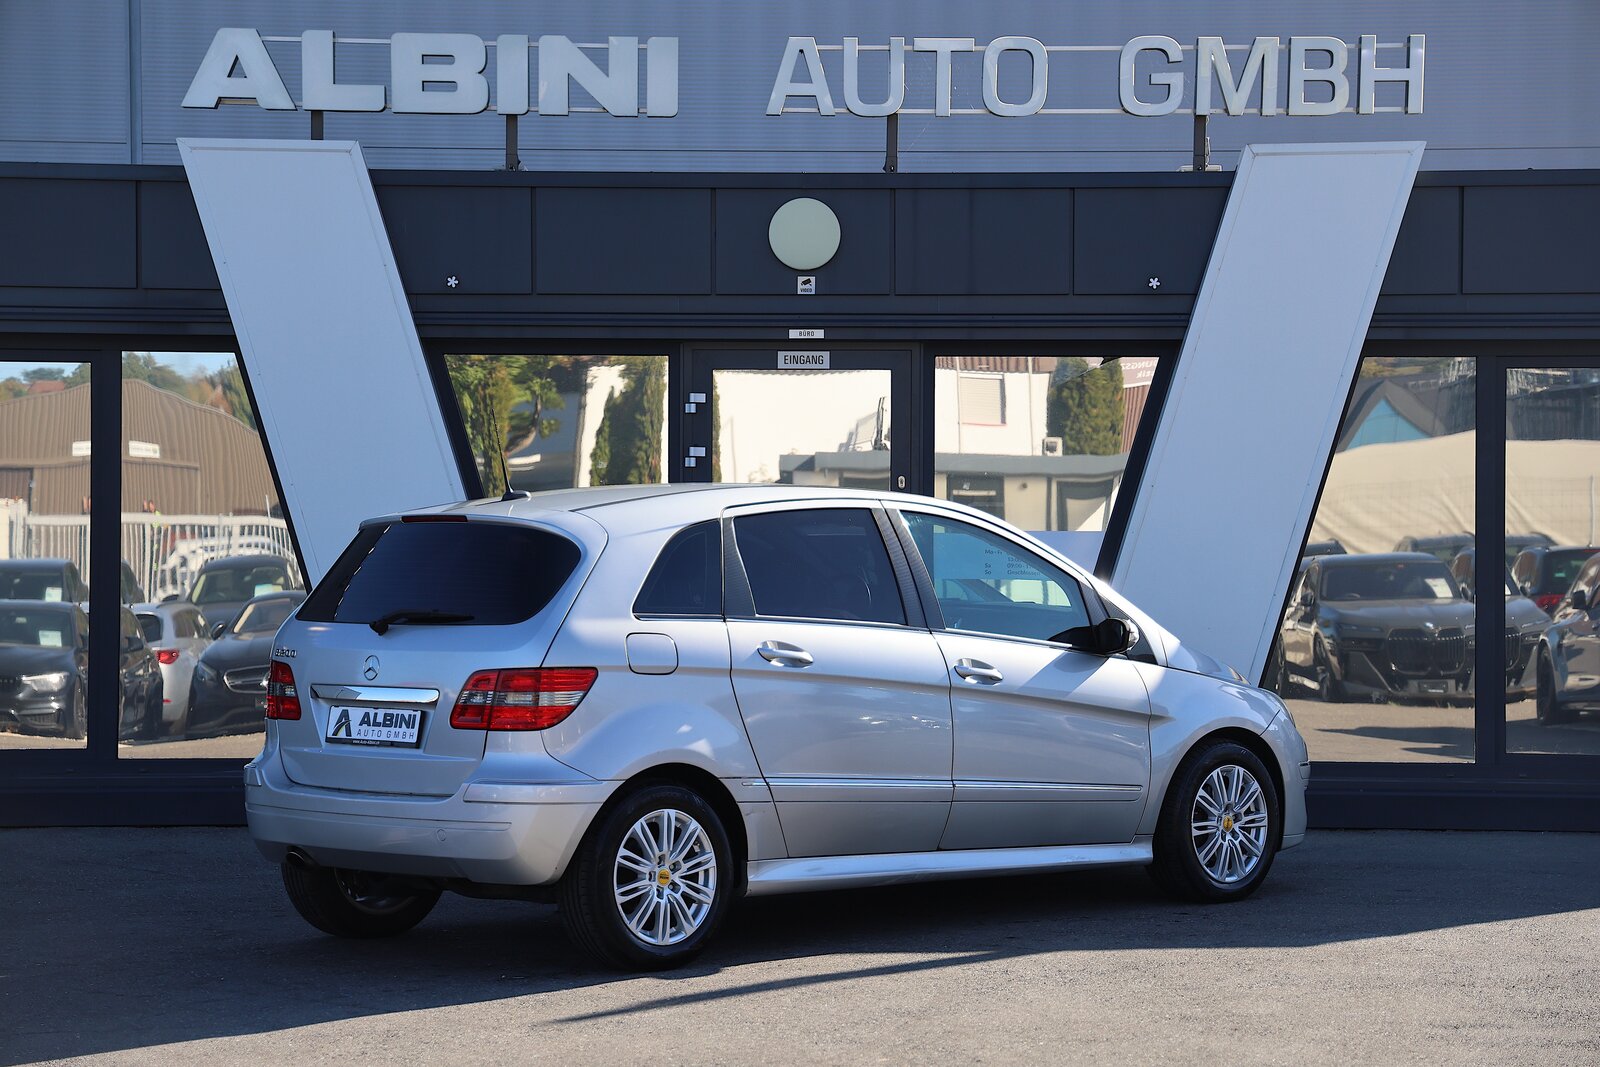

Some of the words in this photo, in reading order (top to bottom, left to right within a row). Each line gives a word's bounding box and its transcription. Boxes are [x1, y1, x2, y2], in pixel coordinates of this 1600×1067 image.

[181, 27, 679, 117] ALBINI
[765, 35, 1049, 118] AUTO
[1119, 34, 1427, 117] GMBH
[783, 354, 824, 365] EINGANG
[358, 712, 416, 729] ALBINI
[356, 729, 382, 738] AUTO
[386, 730, 415, 740] GMBH
